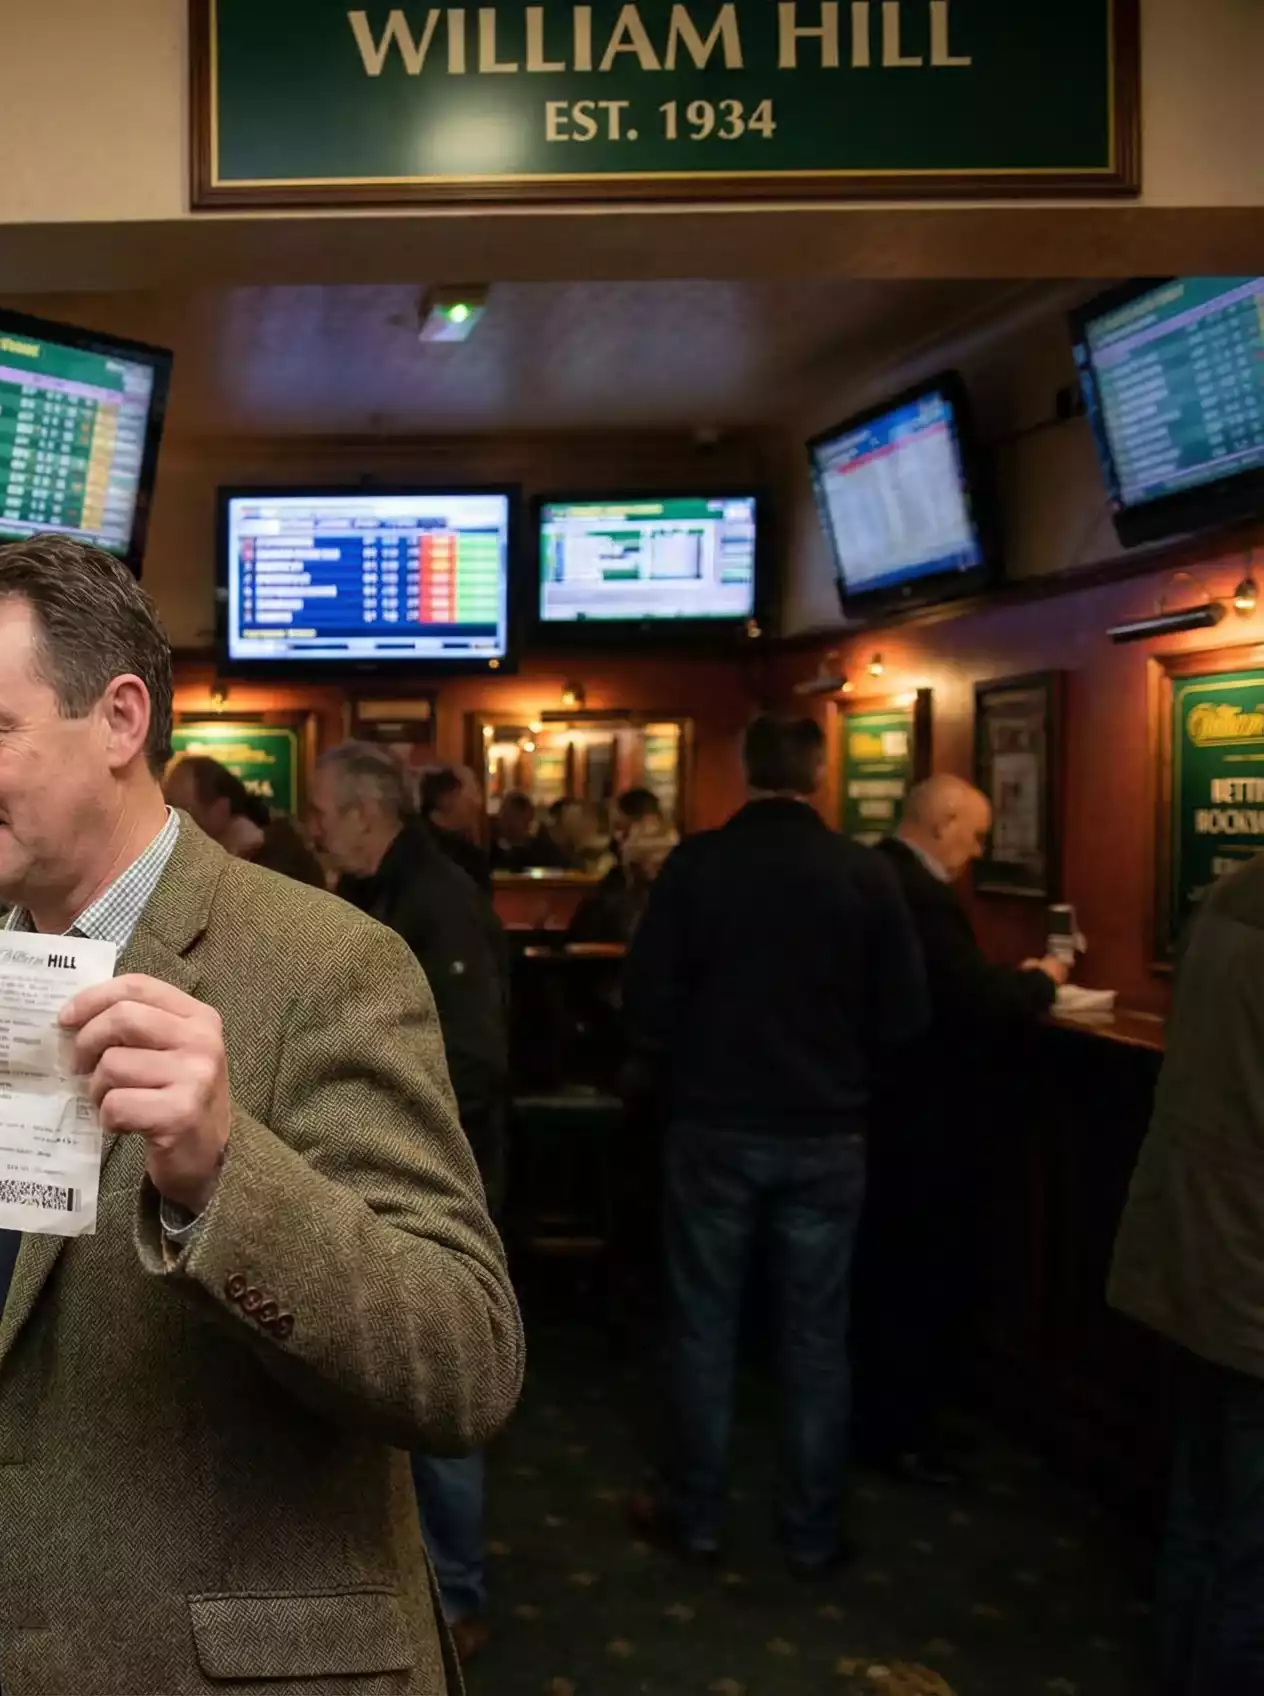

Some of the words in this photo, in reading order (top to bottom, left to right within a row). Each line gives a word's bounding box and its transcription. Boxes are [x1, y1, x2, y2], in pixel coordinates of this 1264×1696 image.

[347, 3, 744, 76] WILLIAM
[778, 1, 972, 68] HILL
[545, 100, 639, 142] EST.
[658, 99, 777, 140] 1934
[47, 953, 77, 970] HILL
